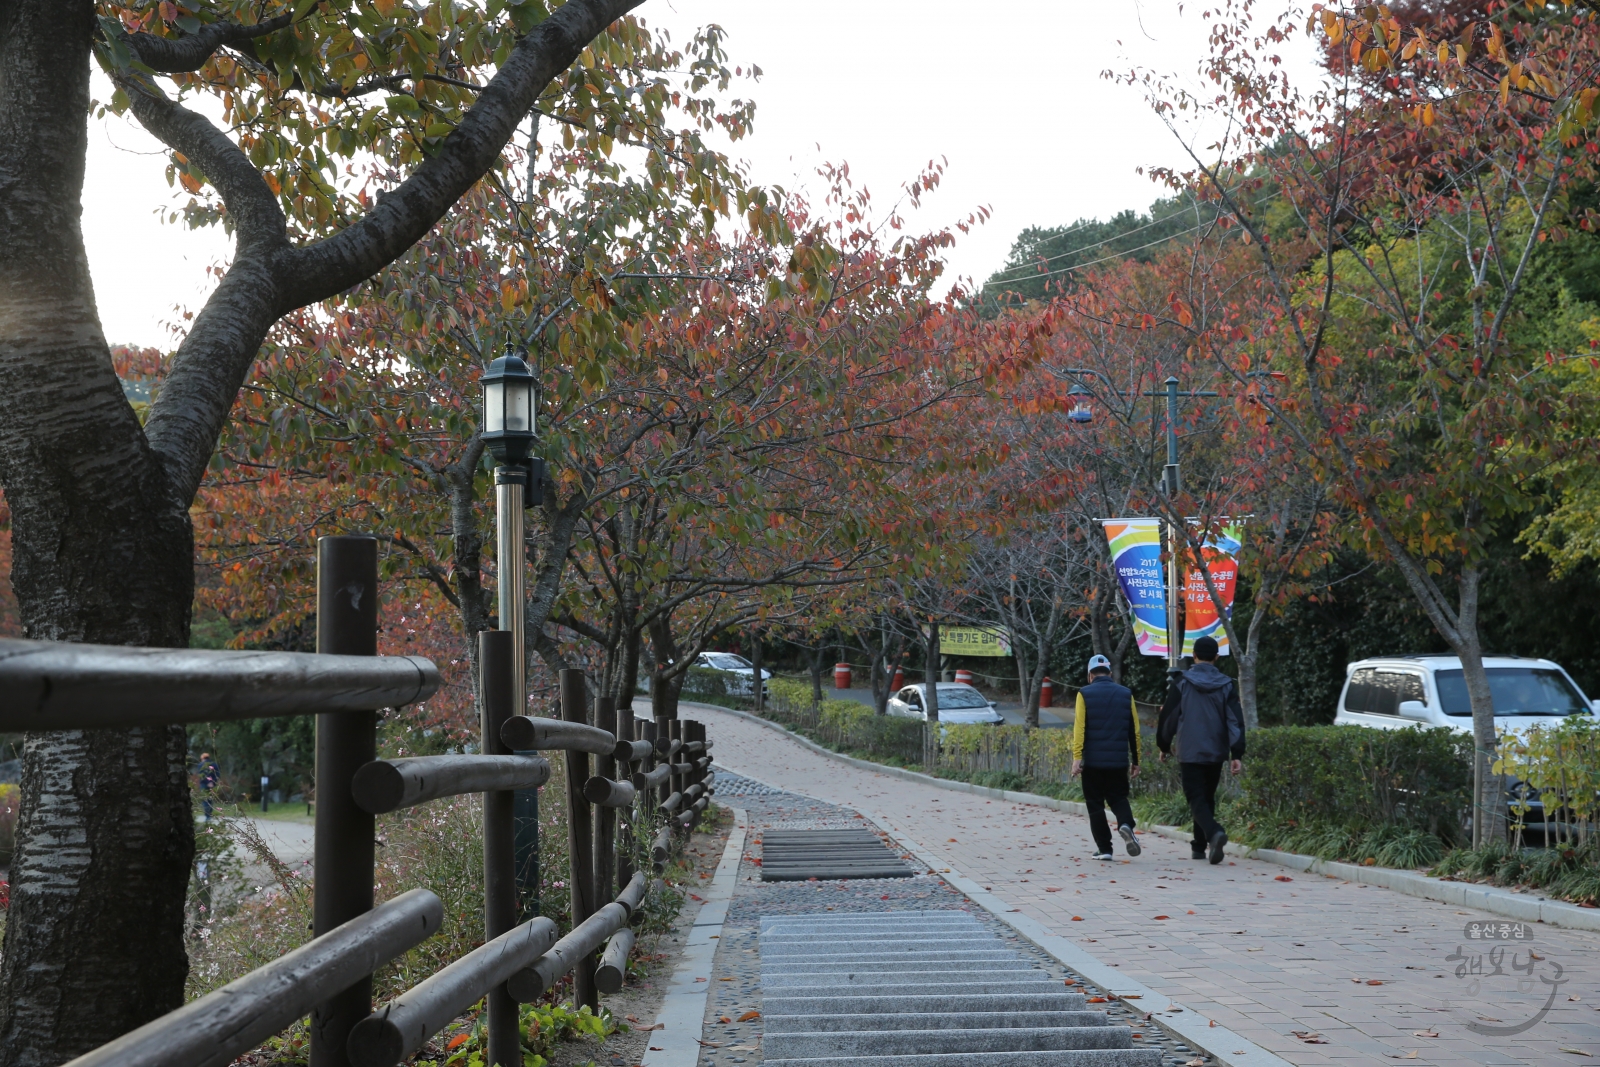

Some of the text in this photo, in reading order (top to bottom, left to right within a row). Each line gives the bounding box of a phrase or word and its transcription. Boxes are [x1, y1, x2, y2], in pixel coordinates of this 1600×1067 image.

[1140, 558, 1157, 567] 2017
[1118, 567, 1159, 579] 선암호수공원
[1189, 570, 1234, 581] 선암수공원
[1127, 578, 1161, 589] 사진공모전
[949, 632, 979, 644] 특별기도
